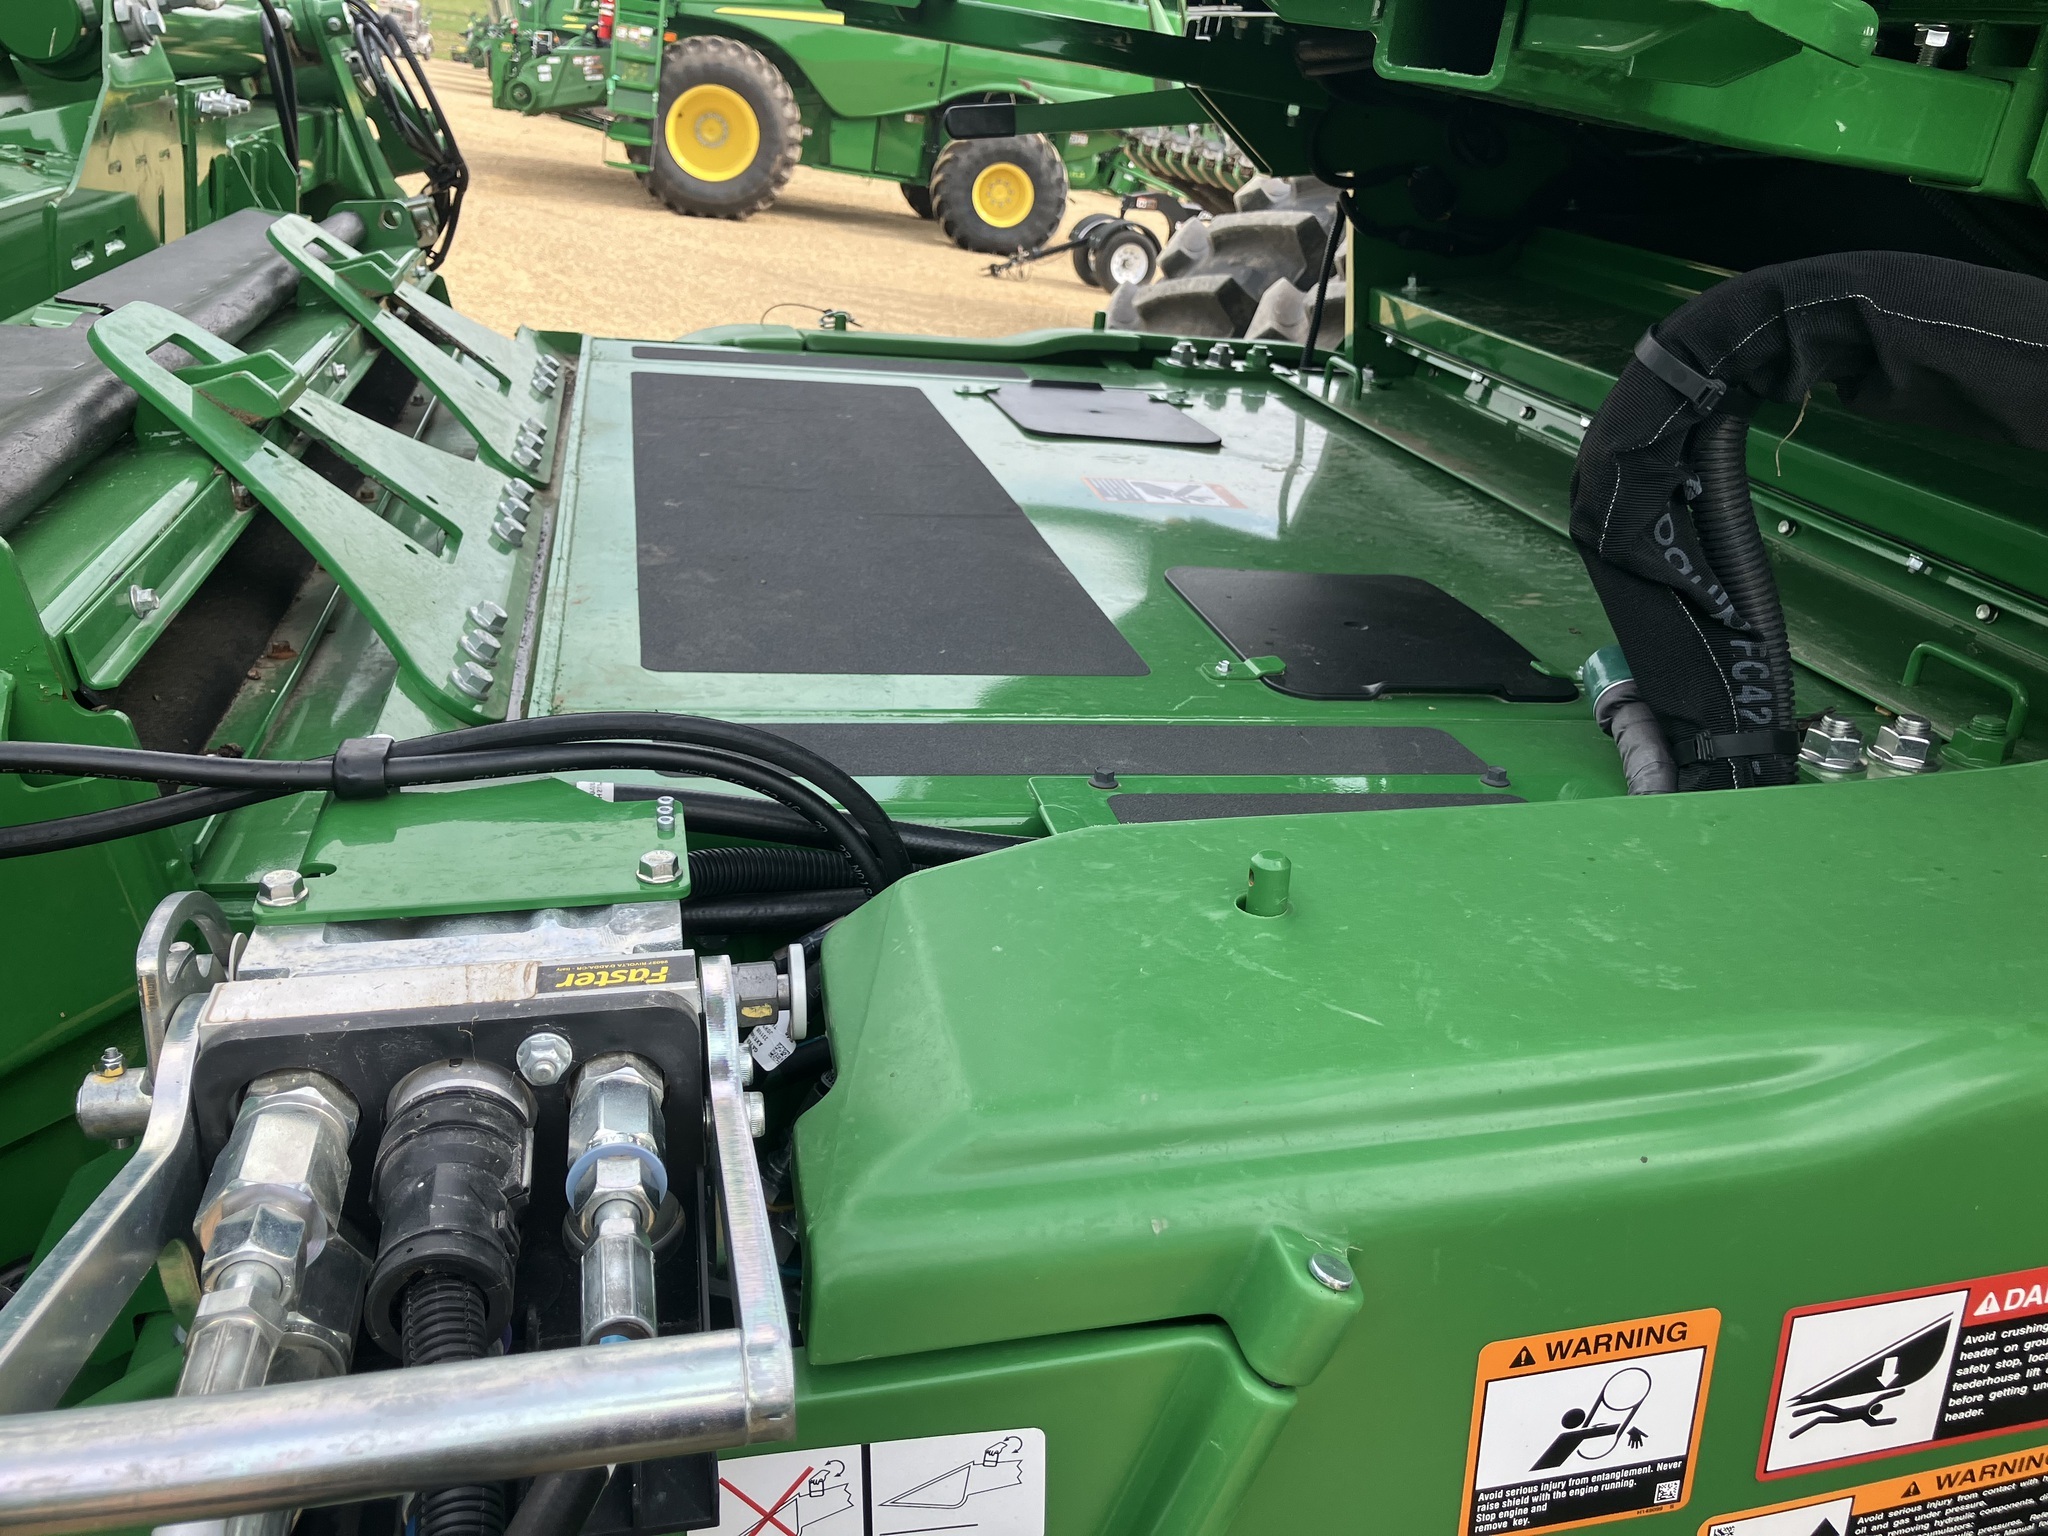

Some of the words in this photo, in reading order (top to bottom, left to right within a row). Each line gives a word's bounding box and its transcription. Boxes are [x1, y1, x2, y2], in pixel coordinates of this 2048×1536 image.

[1730, 640, 1773, 724] FC42
[555, 966, 669, 988] Faster
[1545, 1321, 1688, 1362] WARNING
[1963, 1331, 1997, 1346] Avoid
[1959, 1346, 2000, 1361] header
[2003, 1343, 2019, 1353] on
[1956, 1362, 1990, 1377] safety
[1995, 1357, 2023, 1371] stop,
[1952, 1372, 2021, 1392] feederhouse
[2025, 1368, 2042, 1379] lift
[1948, 1393, 1985, 1407] before
[1988, 1383, 2028, 1402] getting
[1944, 1407, 1985, 1422] header.
[1478, 1490, 1504, 1502] Avoid
[1505, 1484, 1539, 1498] serious
[1540, 1480, 1567, 1492] injury
[1568, 1475, 1589, 1487] from
[1591, 1464, 1654, 1484] entanglement.
[1656, 1460, 1683, 1472] Never
[1936, 1453, 2048, 1490] WARNIN
[1477, 1502, 1500, 1513] raise
[1501, 1495, 1530, 1509] shield
[1531, 1492, 1551, 1503] with
[1552, 1489, 1567, 1500] the
[1569, 1484, 1599, 1497] engine
[1600, 1479, 1637, 1492] running.
[1857, 1513, 1884, 1526] Avoid
[1888, 1504, 1922, 1518] serious
[1926, 1498, 1953, 1511] injury
[1957, 1492, 1979, 1502] from
[1982, 1483, 2017, 1497] contact
[2020, 1477, 2039, 1488] with
[1474, 1521, 1508, 1533] remove
[1512, 1516, 1531, 1528] key.
[1475, 1511, 1496, 1523] Stop
[1498, 1505, 1529, 1520] engine
[1530, 1502, 1548, 1513] and
[1854, 1526, 1867, 1536] oil
[1870, 1521, 1889, 1532] and
[1892, 1518, 1910, 1529] gas
[1914, 1510, 1942, 1522] under
[1934, 1511, 1976, 1527] hydraulic
